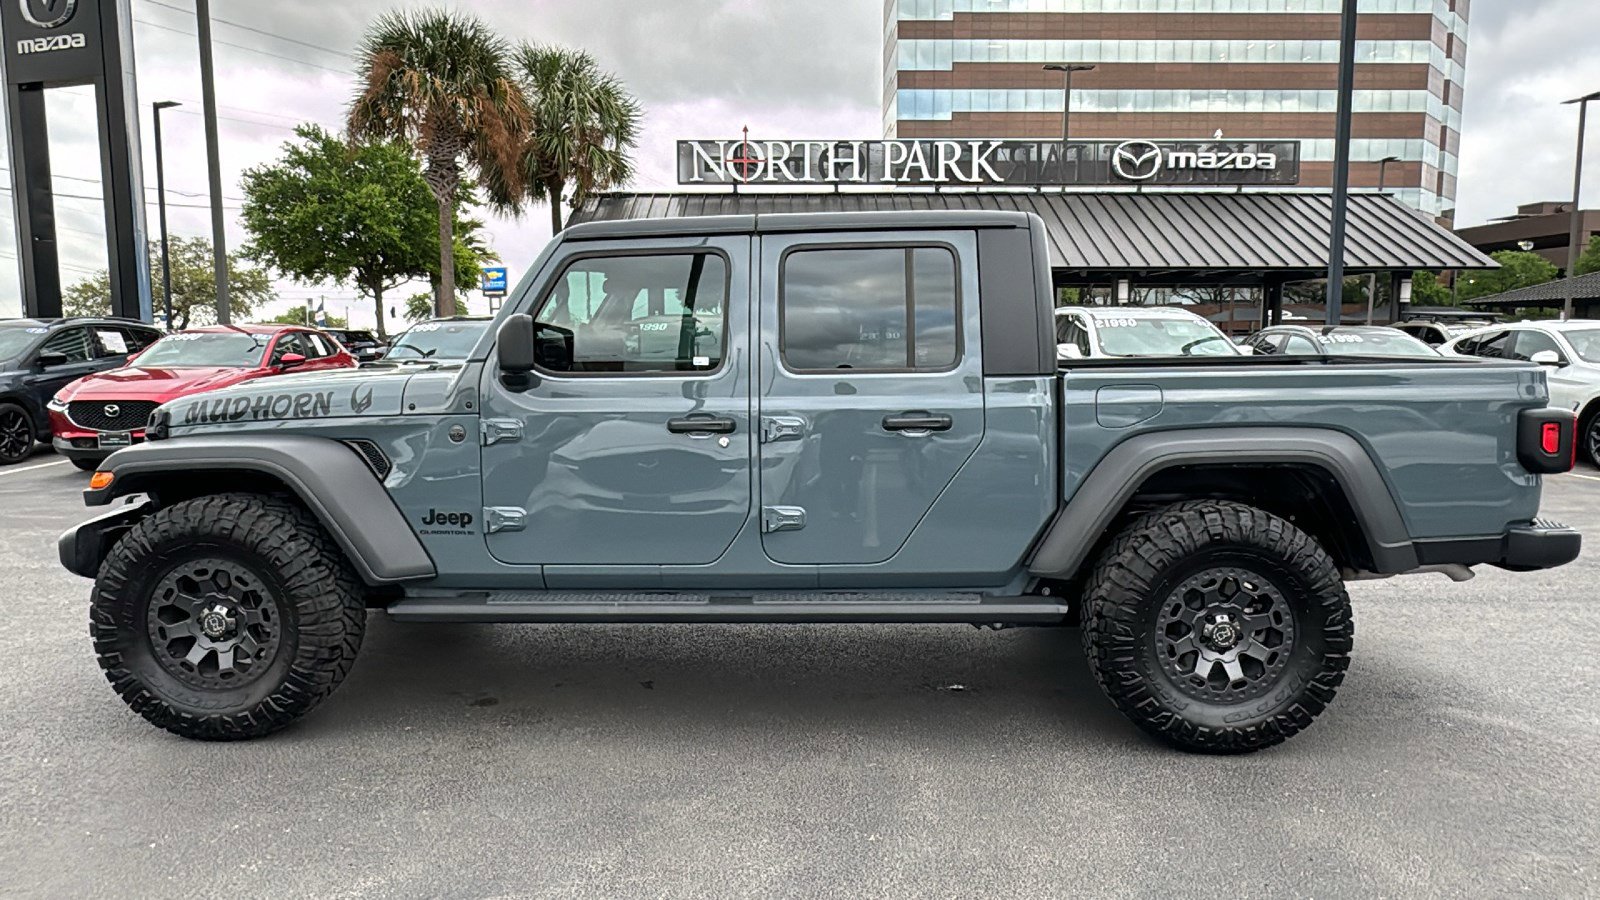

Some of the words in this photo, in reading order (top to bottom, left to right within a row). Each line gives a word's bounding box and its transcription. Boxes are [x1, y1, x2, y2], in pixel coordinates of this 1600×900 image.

[17, 33, 86, 54] mazda
[688, 140, 867, 182] NORTH
[880, 140, 1005, 182] PARK
[1167, 152, 1276, 169] mazda
[185, 391, 334, 424] MUDHORN
[421, 508, 473, 528] Jeep
